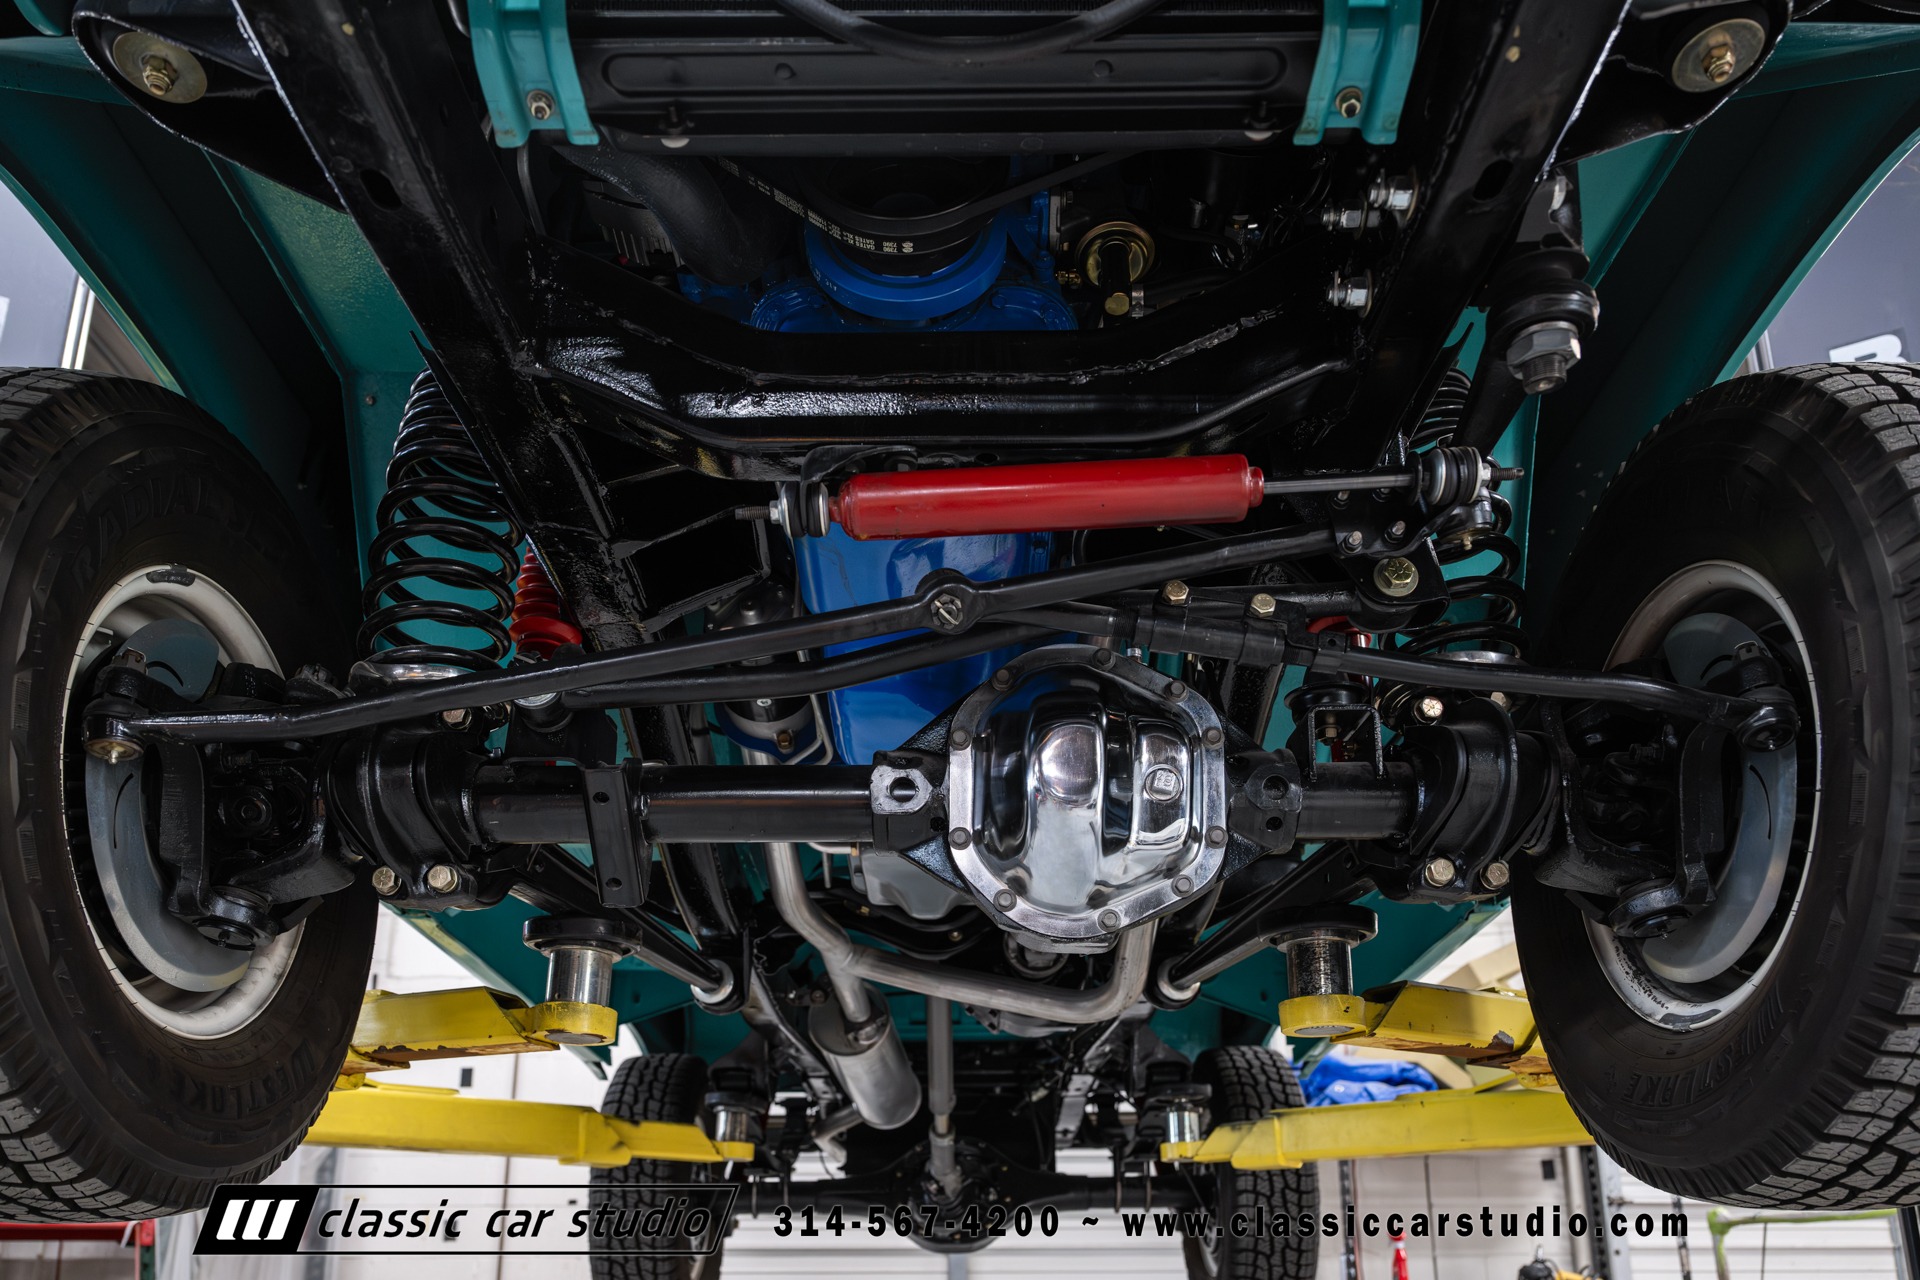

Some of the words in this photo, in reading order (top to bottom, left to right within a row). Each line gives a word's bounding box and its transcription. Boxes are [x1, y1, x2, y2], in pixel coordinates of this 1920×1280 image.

[855, 241, 876, 251] GATES
[71, 472, 216, 594] RADIAL
[1620, 981, 1784, 1106] WESTLAKE
